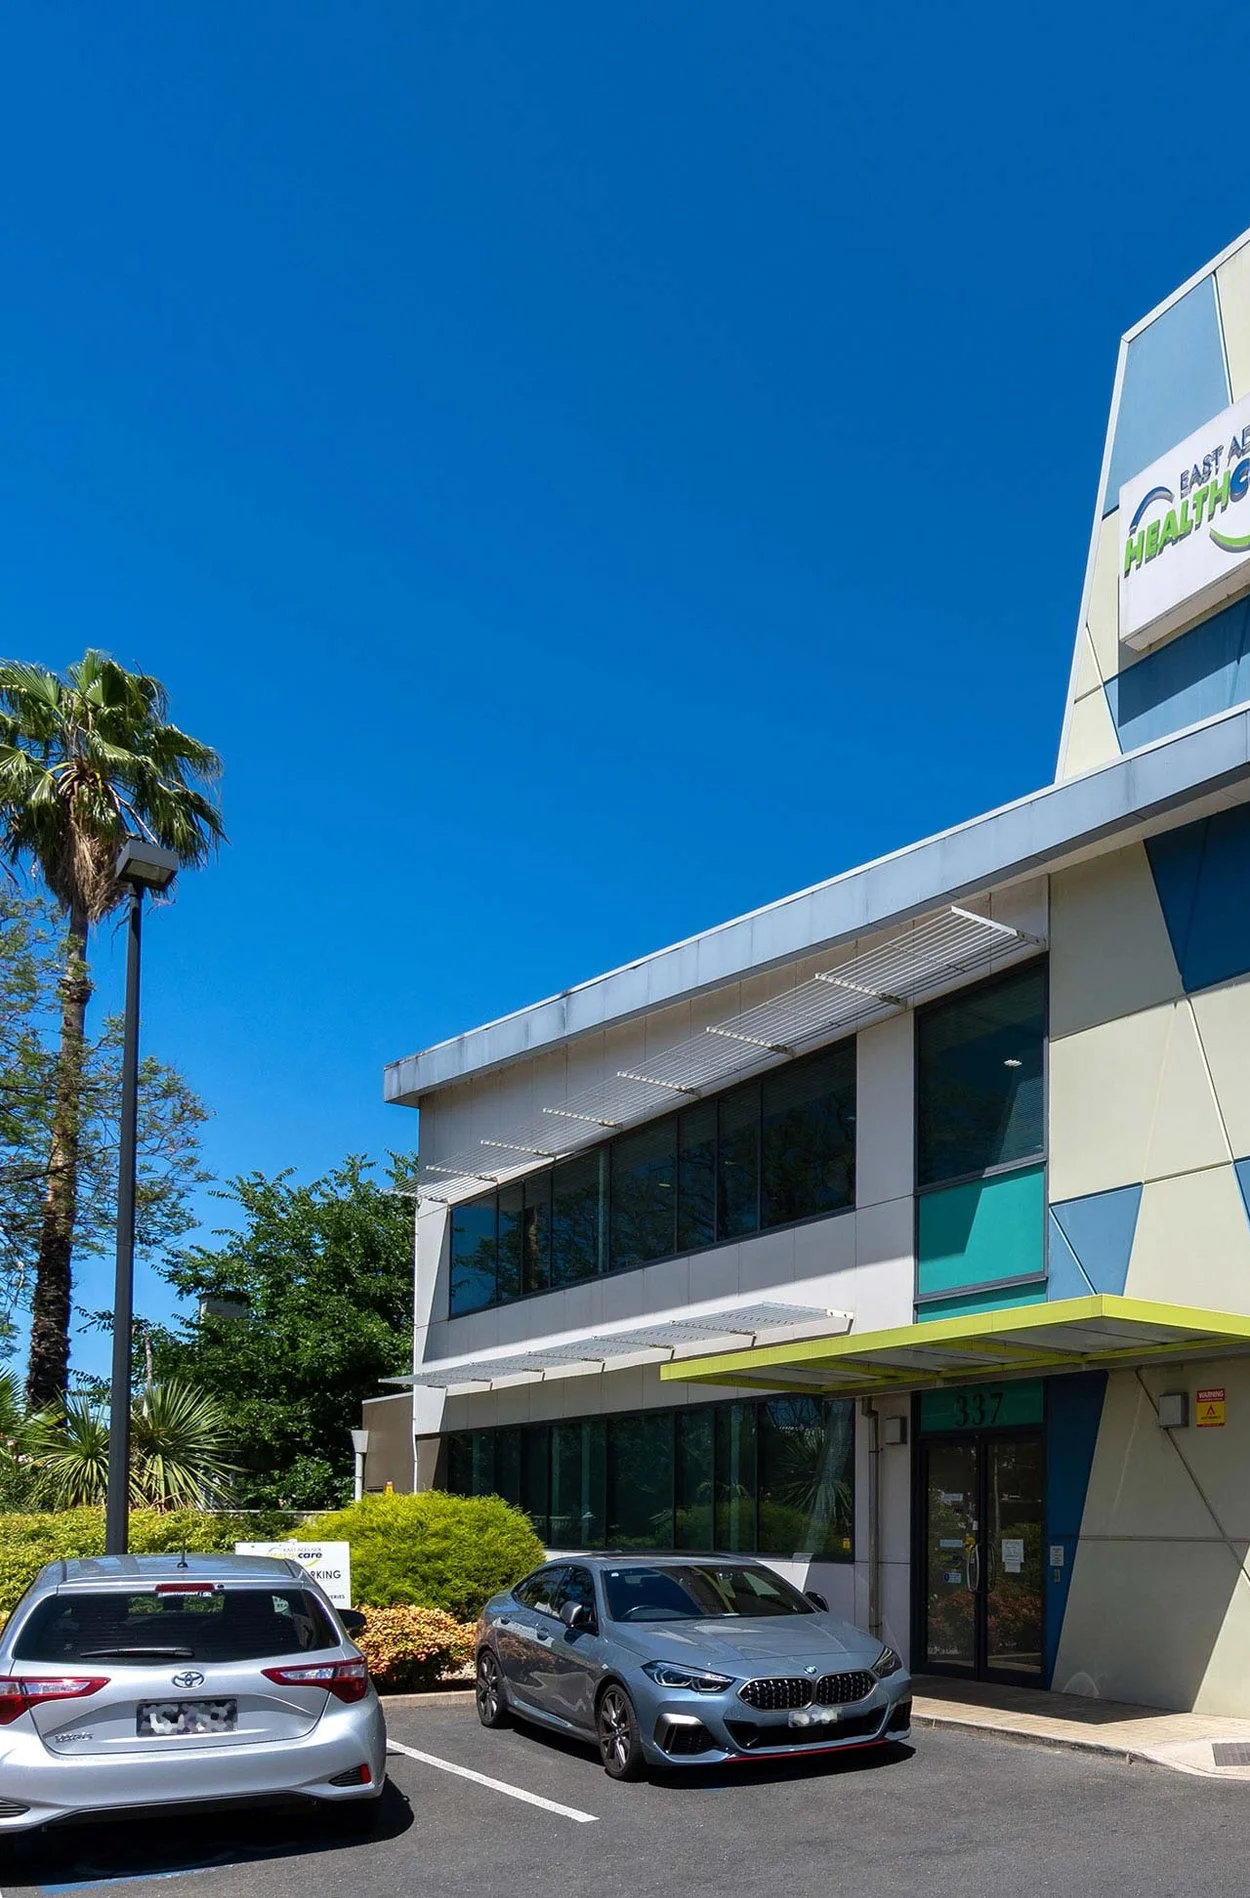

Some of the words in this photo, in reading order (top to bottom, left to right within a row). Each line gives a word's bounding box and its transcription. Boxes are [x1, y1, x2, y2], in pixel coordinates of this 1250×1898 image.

[1180, 445, 1225, 498] EAST
[955, 1392, 1004, 1427] 337
[310, 1569, 341, 1579] RKING
